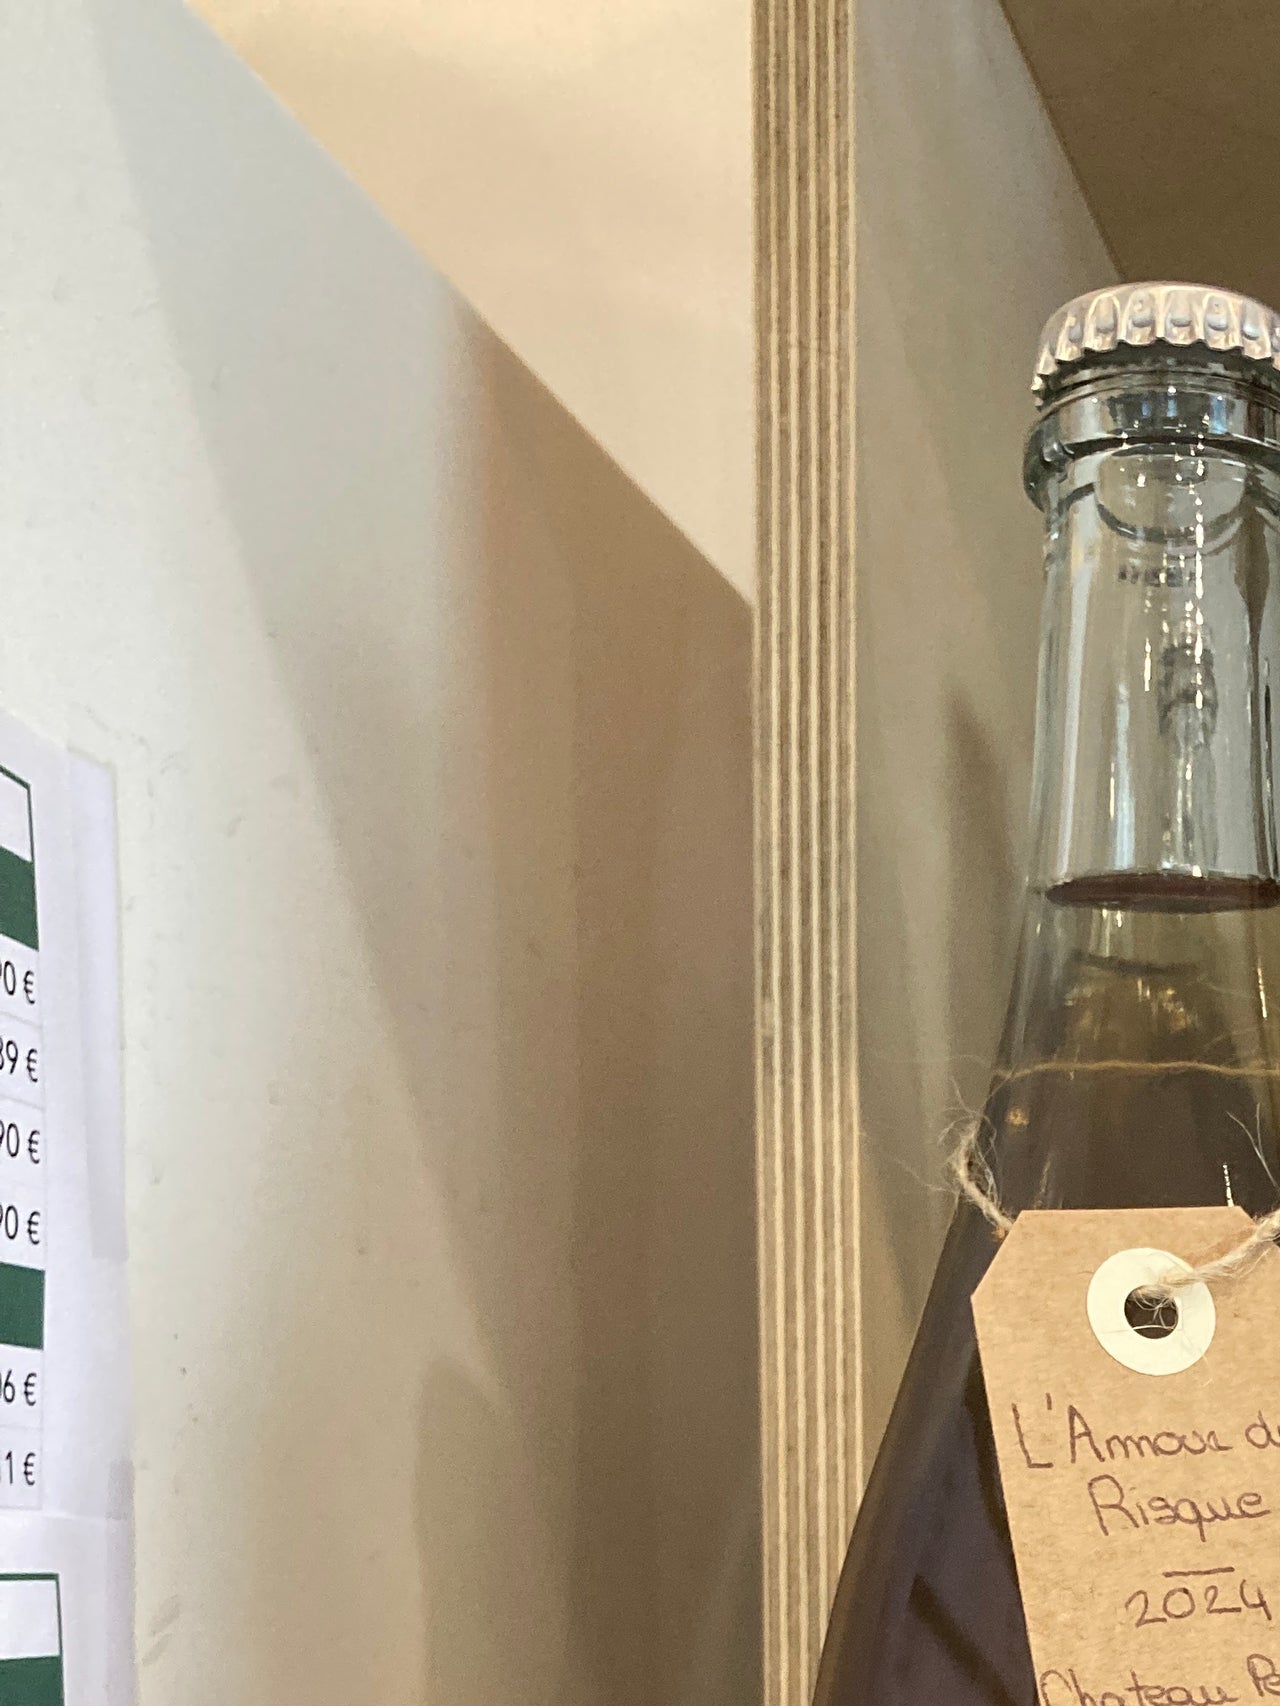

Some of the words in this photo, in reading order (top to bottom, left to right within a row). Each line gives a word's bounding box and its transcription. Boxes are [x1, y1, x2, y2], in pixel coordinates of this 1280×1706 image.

[0, 960, 17, 997] 0
[0, 1203, 20, 1241] 0
[0, 1368, 16, 1404] 6
[1124, 1577, 1272, 1628] 2024
